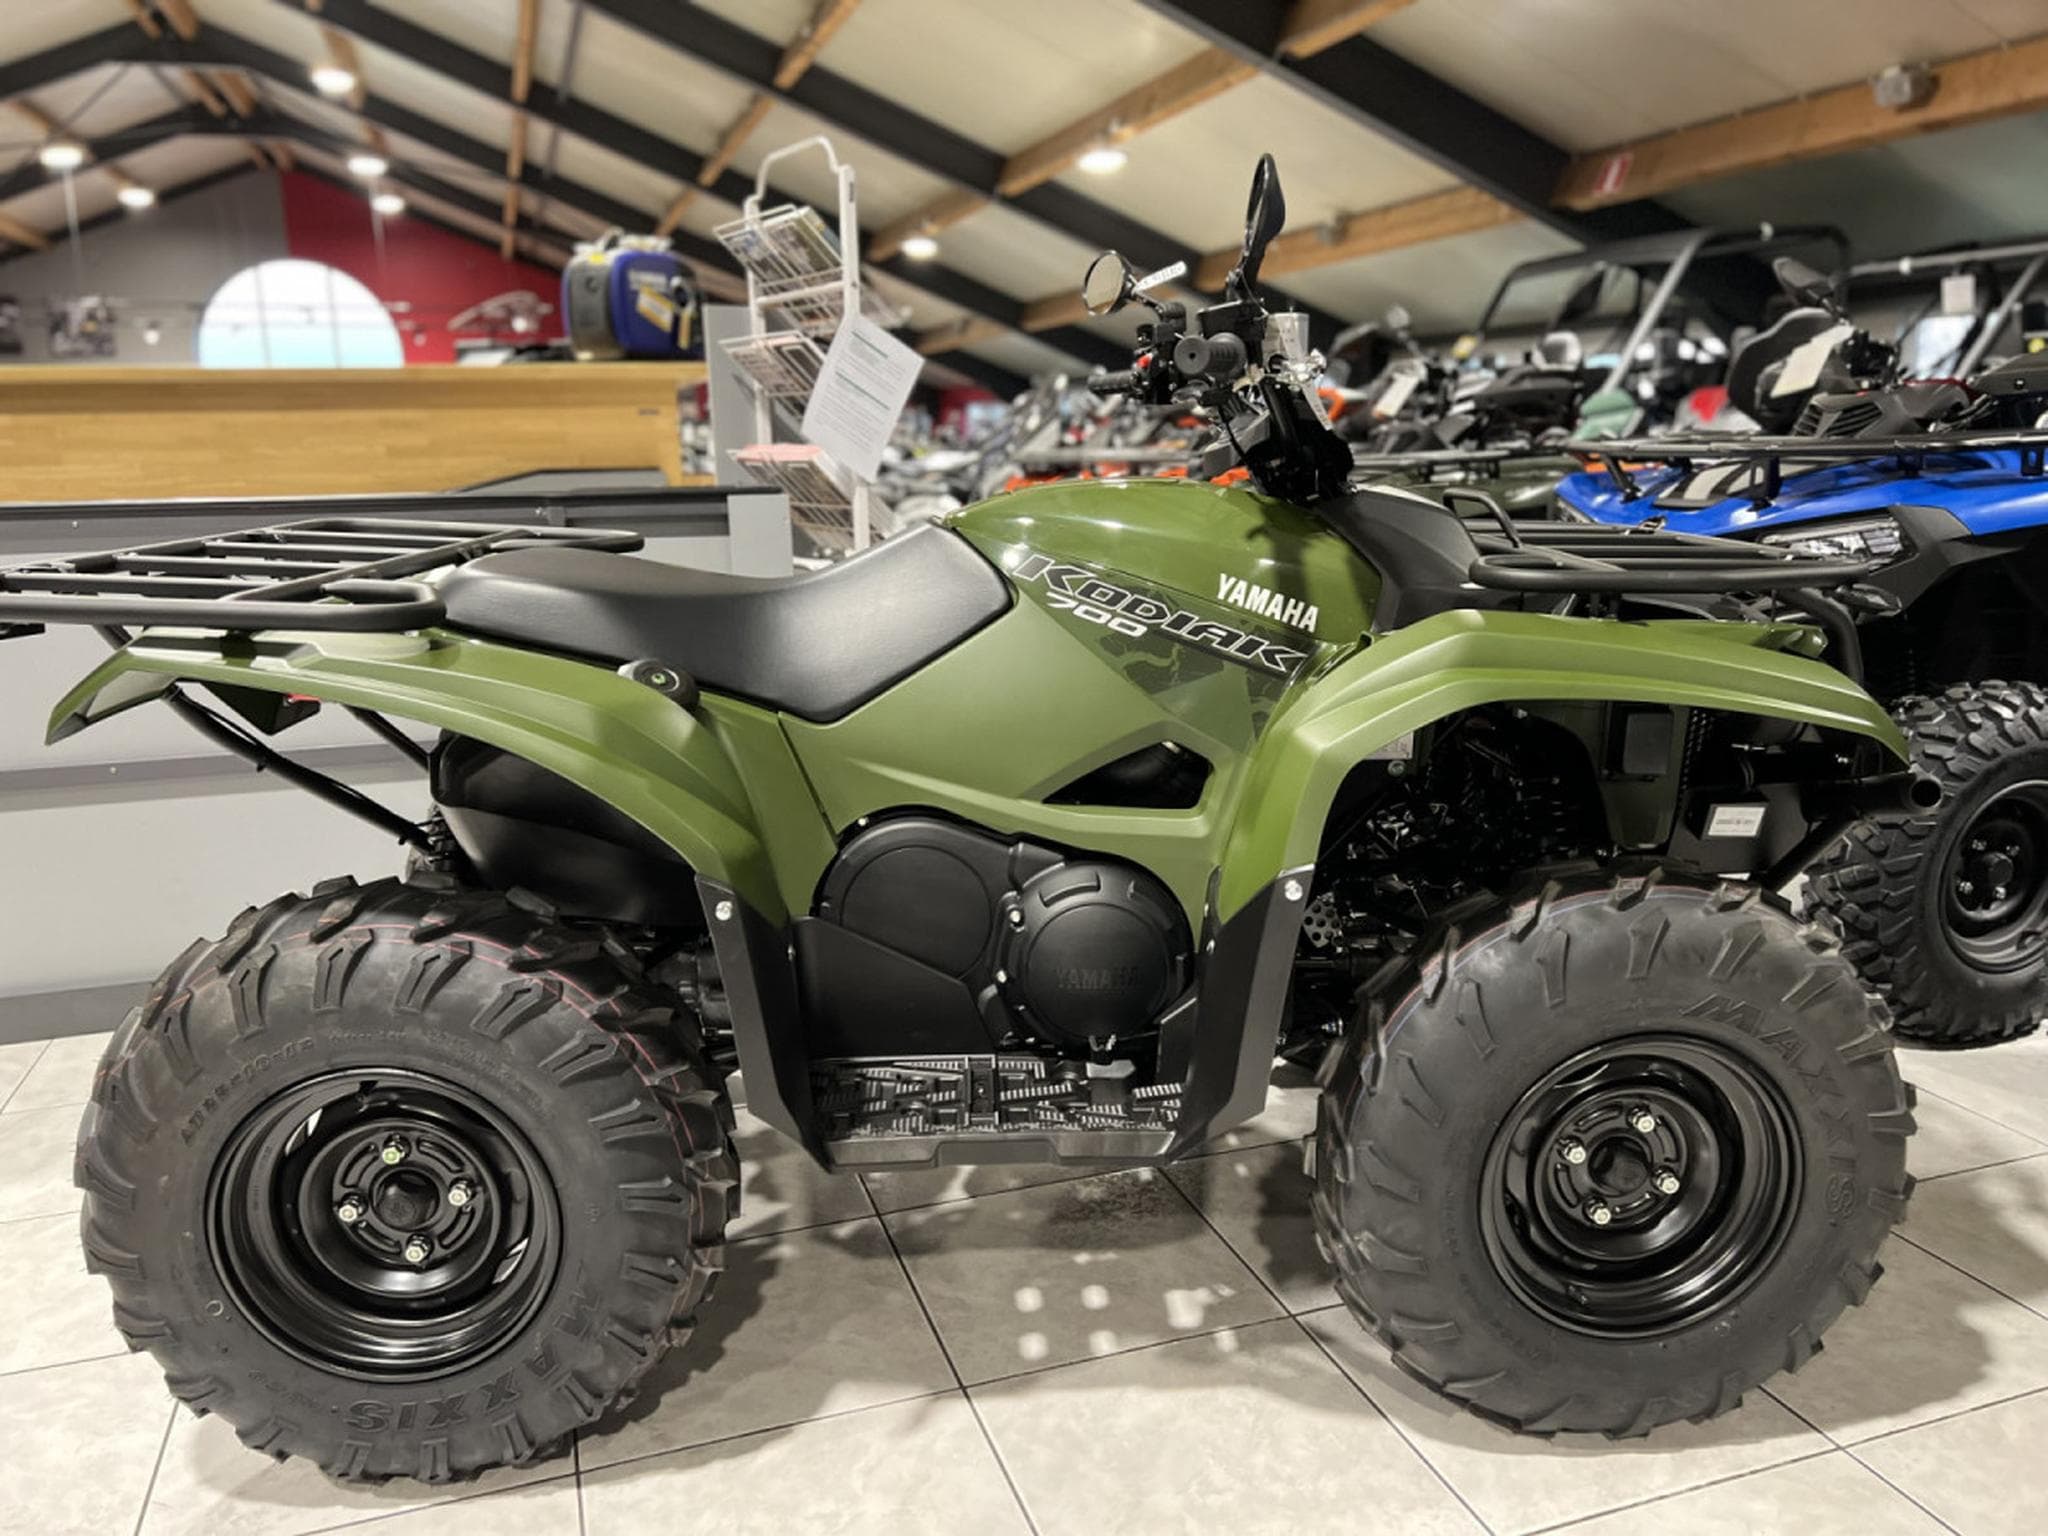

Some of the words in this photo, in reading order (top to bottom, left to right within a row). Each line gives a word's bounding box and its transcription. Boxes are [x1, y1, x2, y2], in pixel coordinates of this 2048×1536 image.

[1012, 553, 1309, 673] KODIAK
[1045, 591, 1148, 638] 700
[1214, 572, 1319, 633] YAMAHA
[1677, 992, 1857, 1222] MAXXIS
[344, 1258, 601, 1432] MAXXIS
